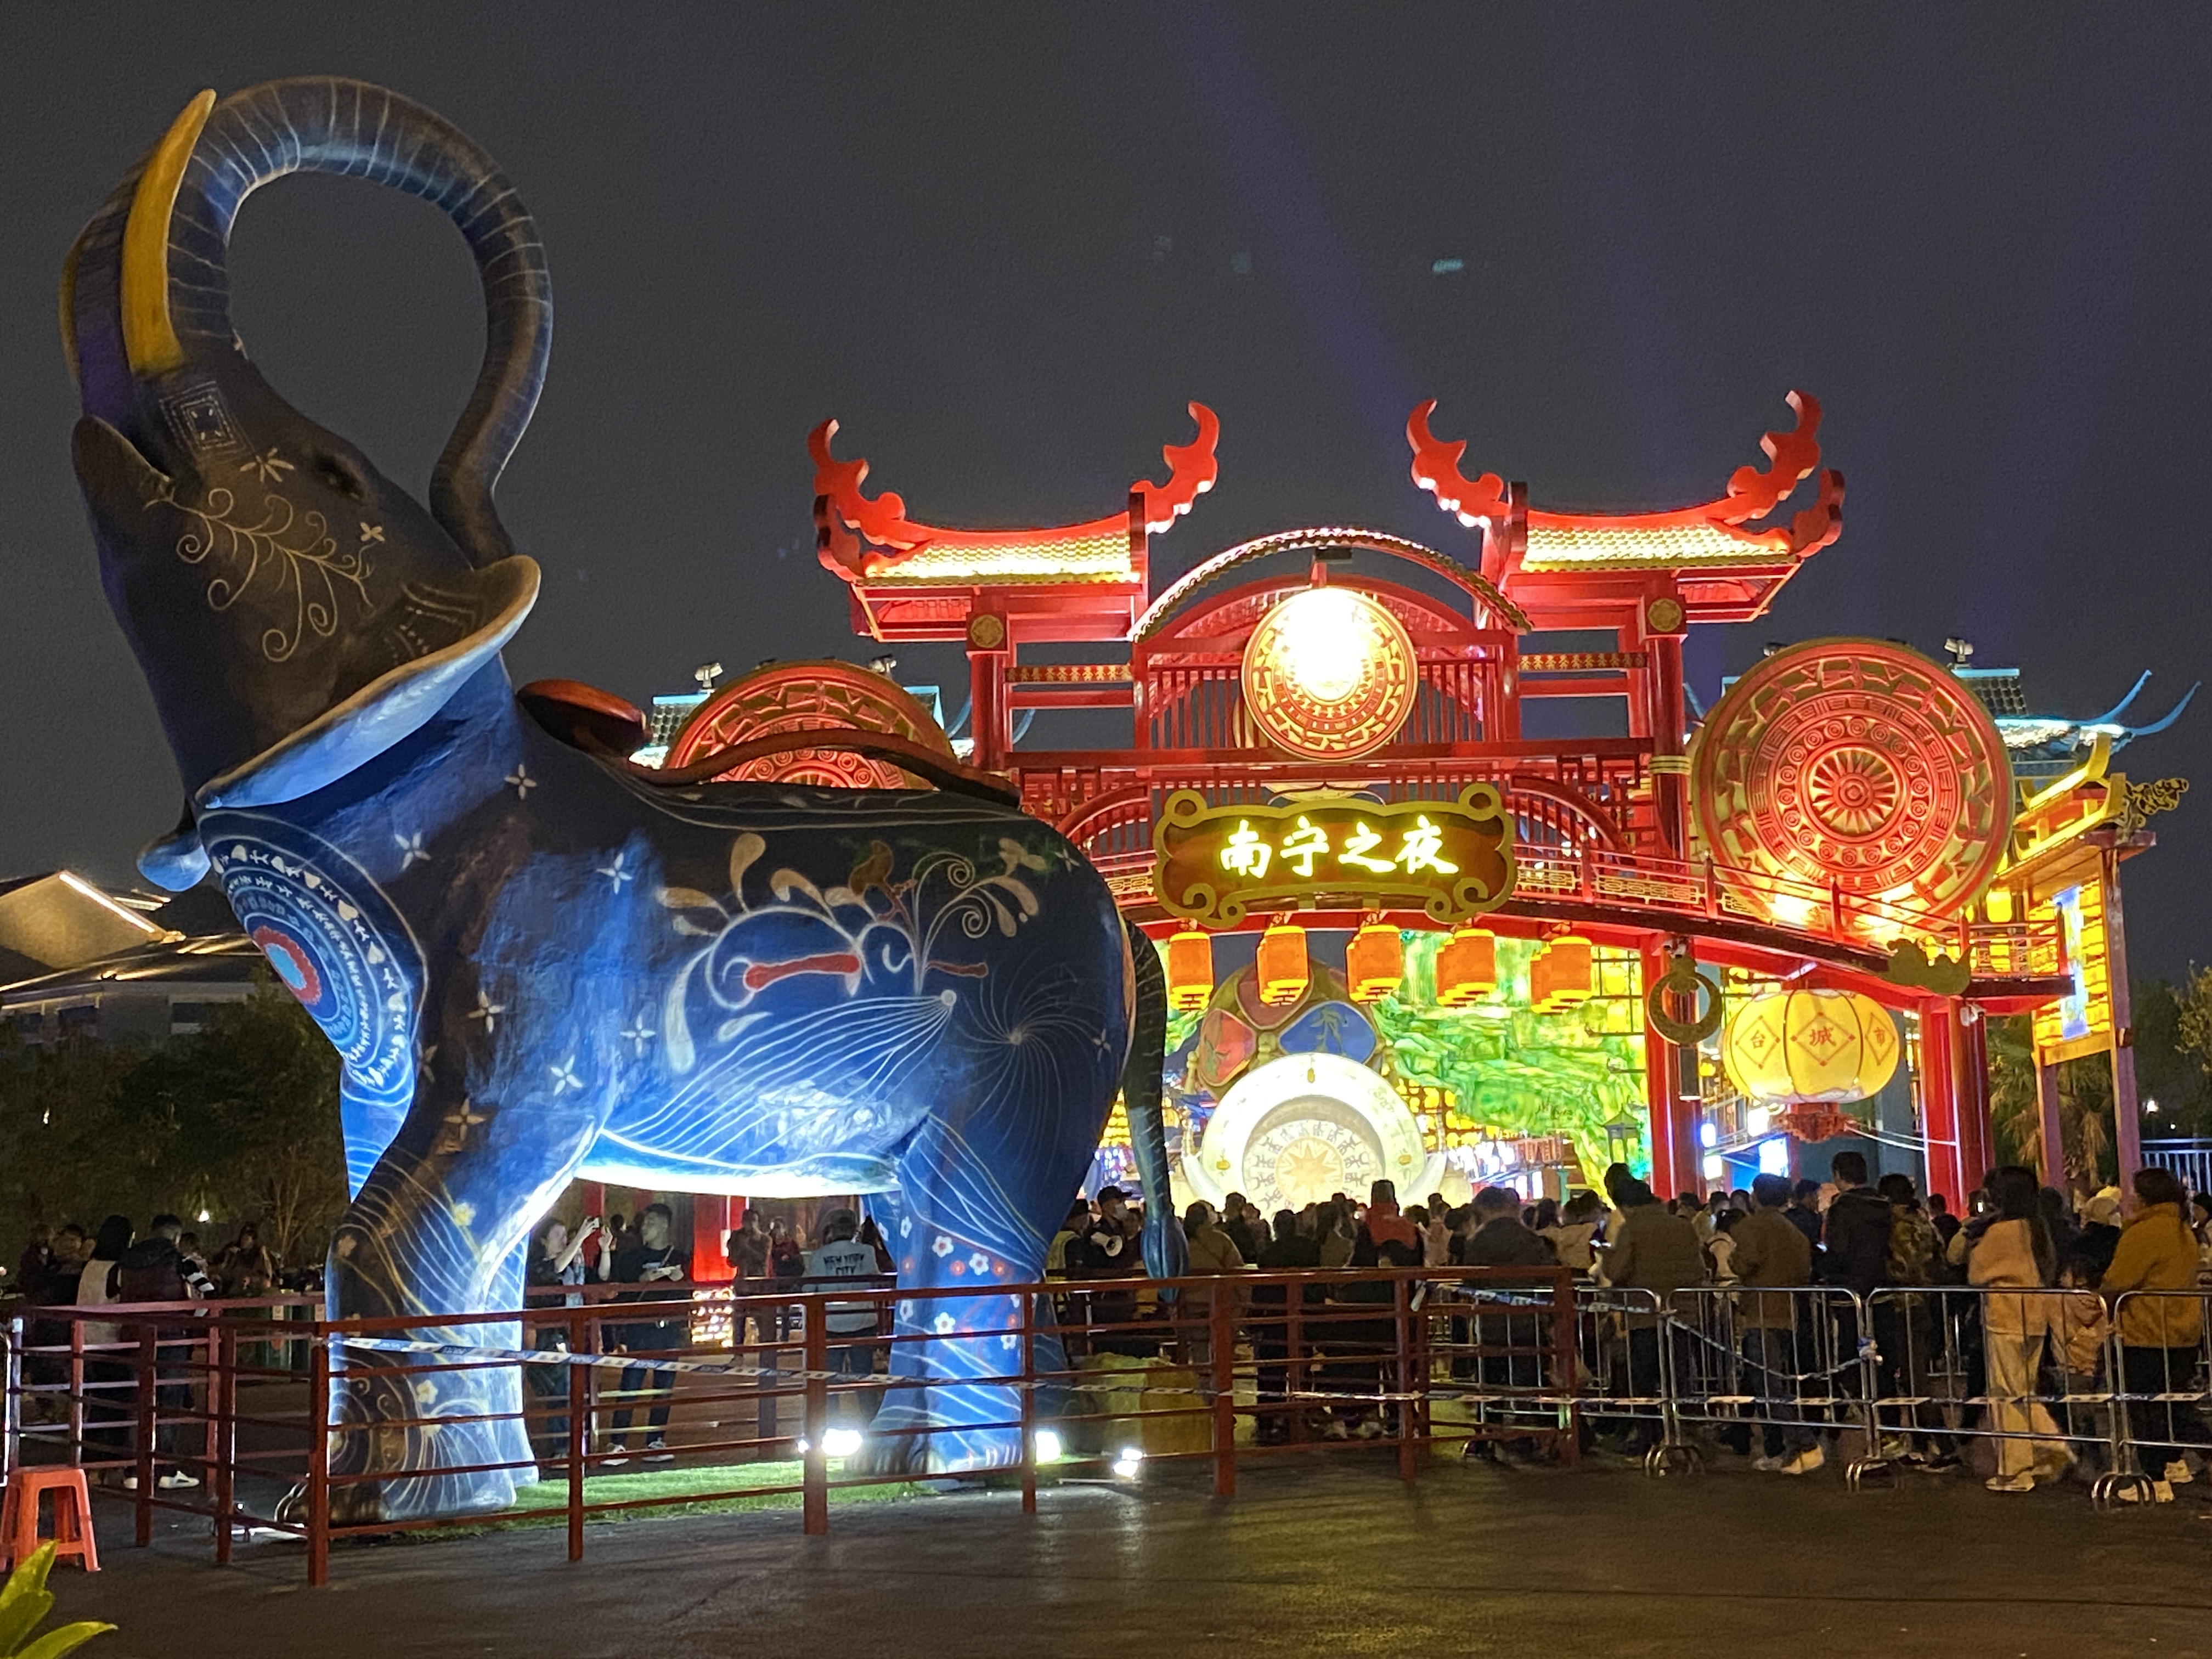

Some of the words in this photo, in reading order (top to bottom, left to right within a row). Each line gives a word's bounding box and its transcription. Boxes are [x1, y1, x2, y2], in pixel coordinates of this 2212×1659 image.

[1220, 815, 1459, 879] 南宁之夜
[1750, 1029, 1766, 1049] 台
[1809, 1026, 1837, 1046] 城
[1874, 1026, 1885, 1047] 市
